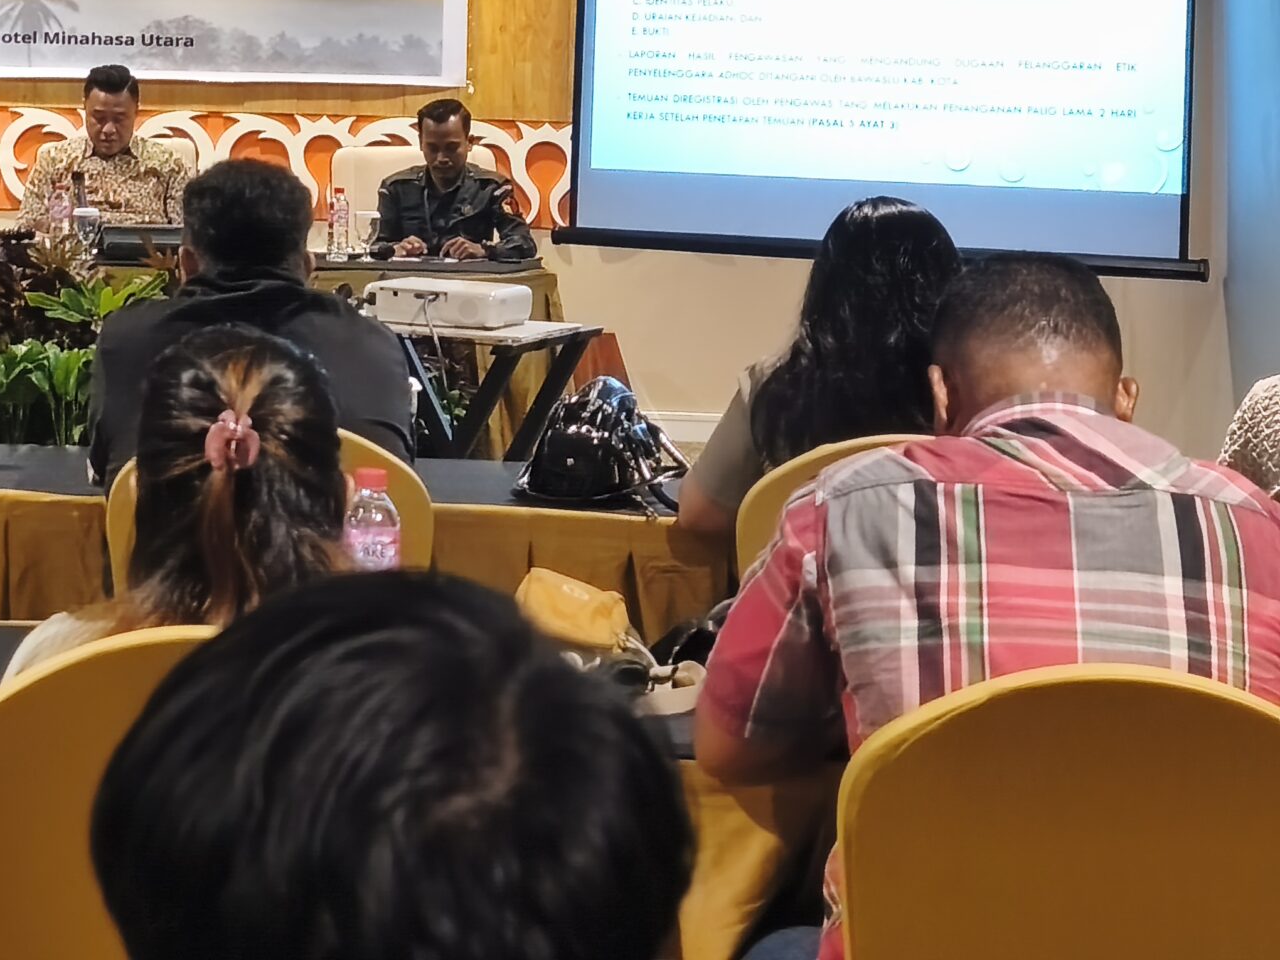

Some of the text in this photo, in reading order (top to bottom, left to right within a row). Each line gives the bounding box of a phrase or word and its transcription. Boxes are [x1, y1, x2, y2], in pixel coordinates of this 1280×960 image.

[644, 13, 682, 22] URAIAN
[44, 31, 135, 46] Minahasa
[140, 33, 195, 48] Utara
[628, 51, 676, 60] LAPORAN
[688, 52, 716, 61] HASIL
[1018, 61, 1102, 70] PELANGGARAN
[1116, 62, 1138, 71] ETIK
[628, 69, 713, 78] PENYELENGGARA
[627, 94, 668, 103] TEMUAN
[672, 95, 738, 104] DIREGISTRASI
[742, 97, 768, 106] OLEH
[773, 99, 833, 108] PENGAWAS
[942, 104, 1022, 113] PENANGANAN
[1062, 107, 1093, 116] LAMA
[1110, 108, 1137, 117] HARI
[627, 112, 655, 121] KERJA
[658, 114, 699, 123] SETELAH
[702, 115, 759, 124] PENETAPAN
[762, 117, 805, 126] TEMUAN
[859, 119, 884, 128] AYAT
